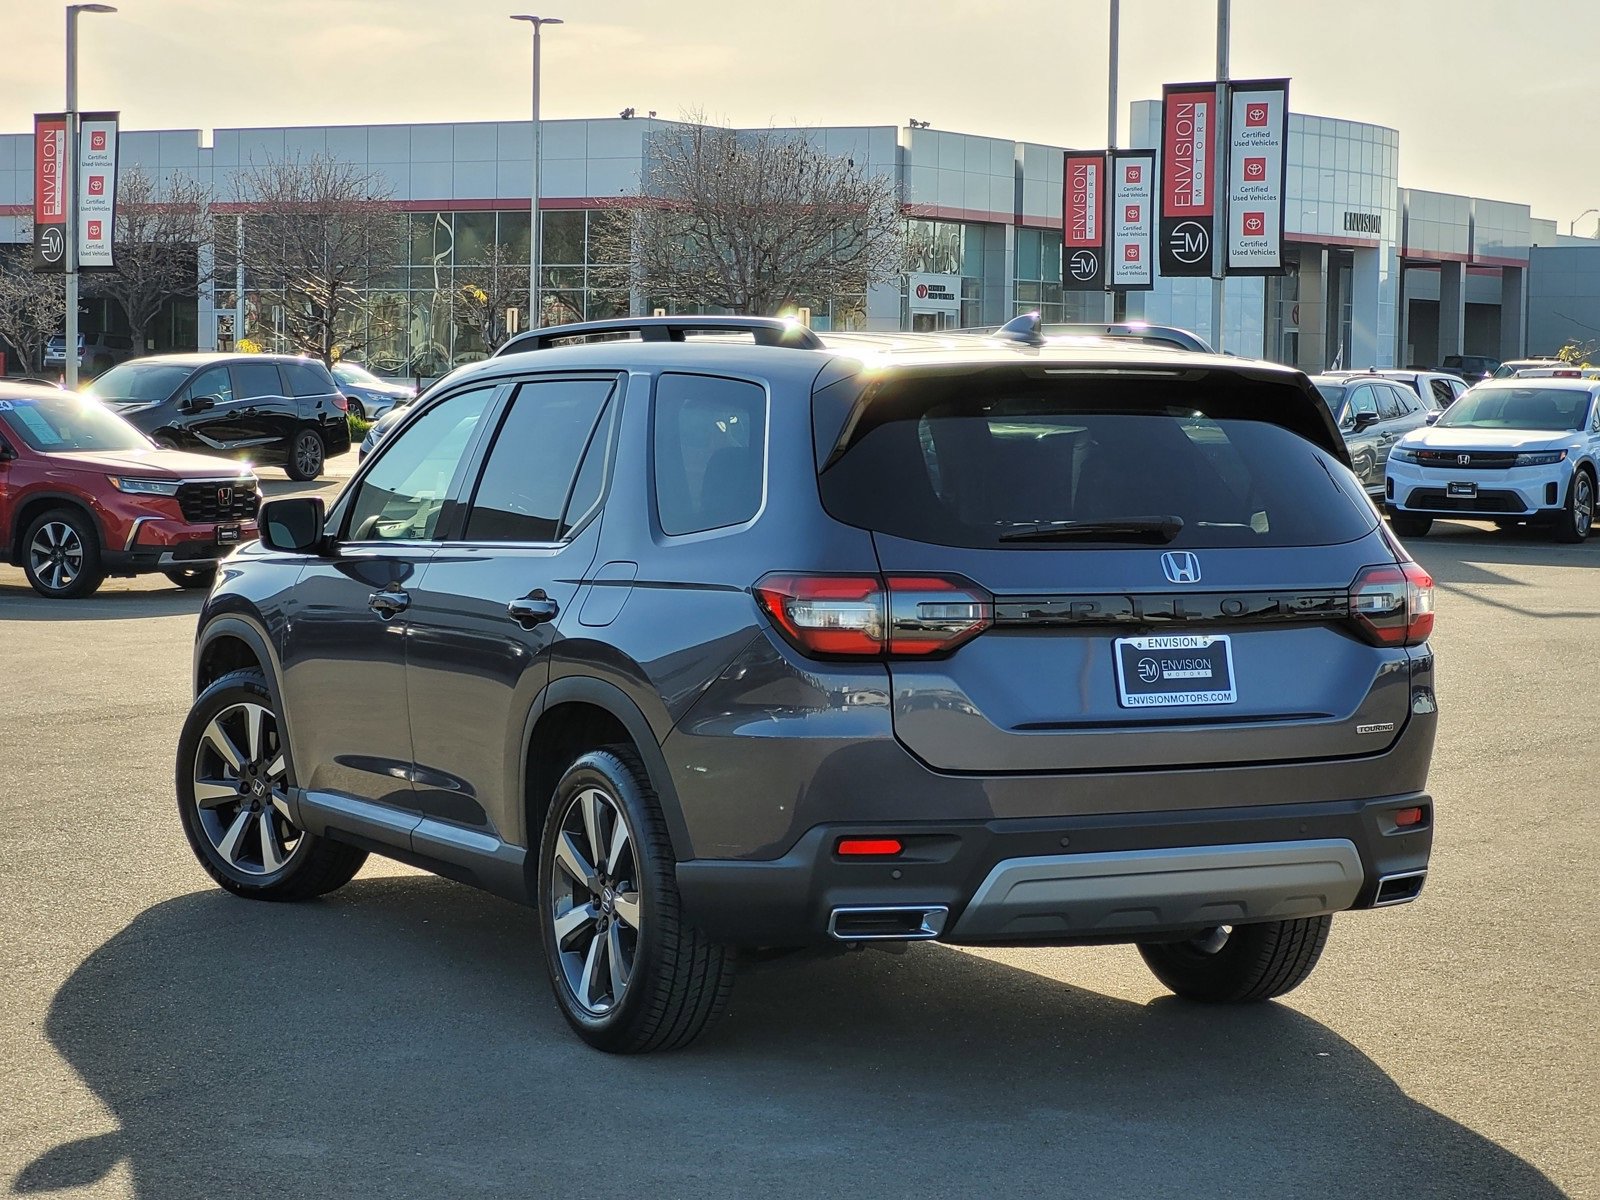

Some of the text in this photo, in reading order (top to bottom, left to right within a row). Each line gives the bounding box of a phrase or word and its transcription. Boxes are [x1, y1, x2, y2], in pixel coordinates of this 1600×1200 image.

[1250, 139, 1279, 147] Vehicles
[1174, 102, 1193, 207] ENVISION
[1195, 111, 1205, 197] MOTORS
[43, 130, 56, 216] ENVISION
[1073, 164, 1086, 240] ENVISION
[1232, 194, 1248, 202] Used
[1344, 211, 1381, 234] ENVISION
[1239, 240, 1268, 248] Certified
[1070, 594, 1297, 619] PILOT
[1147, 637, 1198, 648] ENVISION
[1161, 658, 1212, 671] ENVISION
[1127, 692, 1232, 705] ENVISIONMOTORS.COM
[1360, 724, 1393, 732] TOURING
